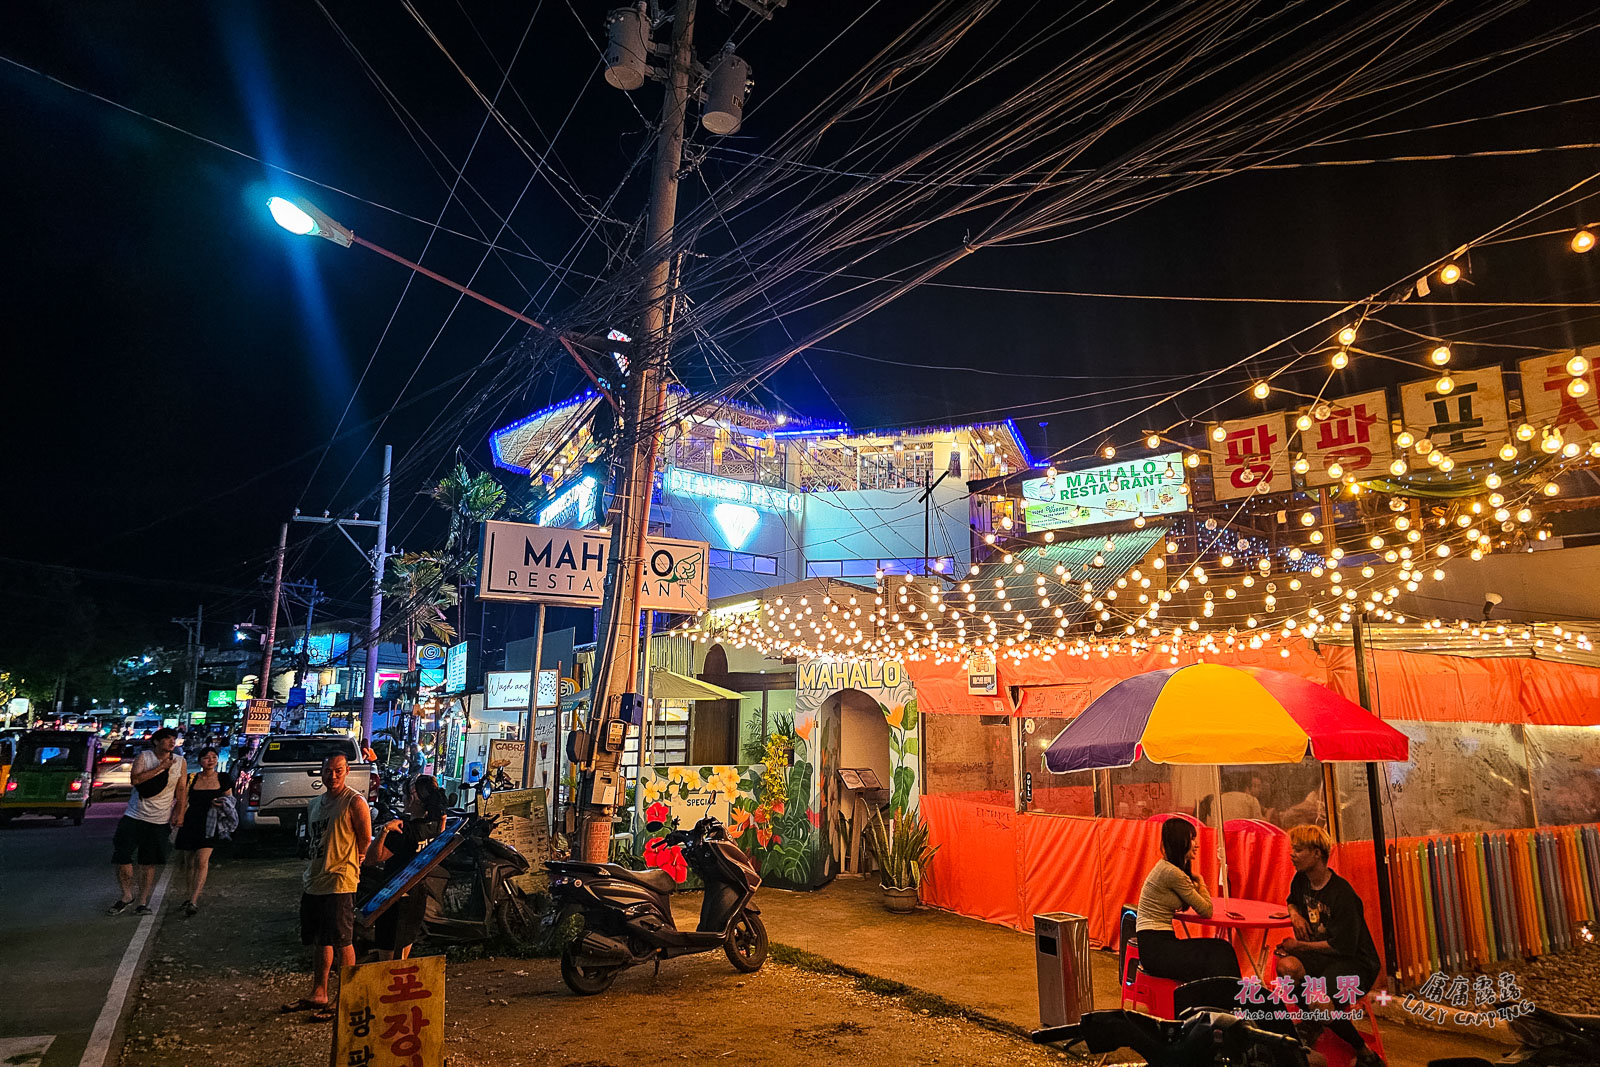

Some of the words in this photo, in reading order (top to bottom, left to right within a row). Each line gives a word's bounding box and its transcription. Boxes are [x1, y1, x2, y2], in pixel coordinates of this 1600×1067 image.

[1060, 472, 1166, 501] RESTARANT
[1066, 461, 1157, 489] MAHALO
[670, 469, 748, 501] DIAMOND
[751, 487, 800, 514] RESTO
[523, 535, 675, 577] MAHO
[507, 569, 687, 599] RESTAANT
[488, 678, 513, 697] Wash
[798, 660, 901, 691] MAHALO
[379, 965, 433, 1067] 포장
